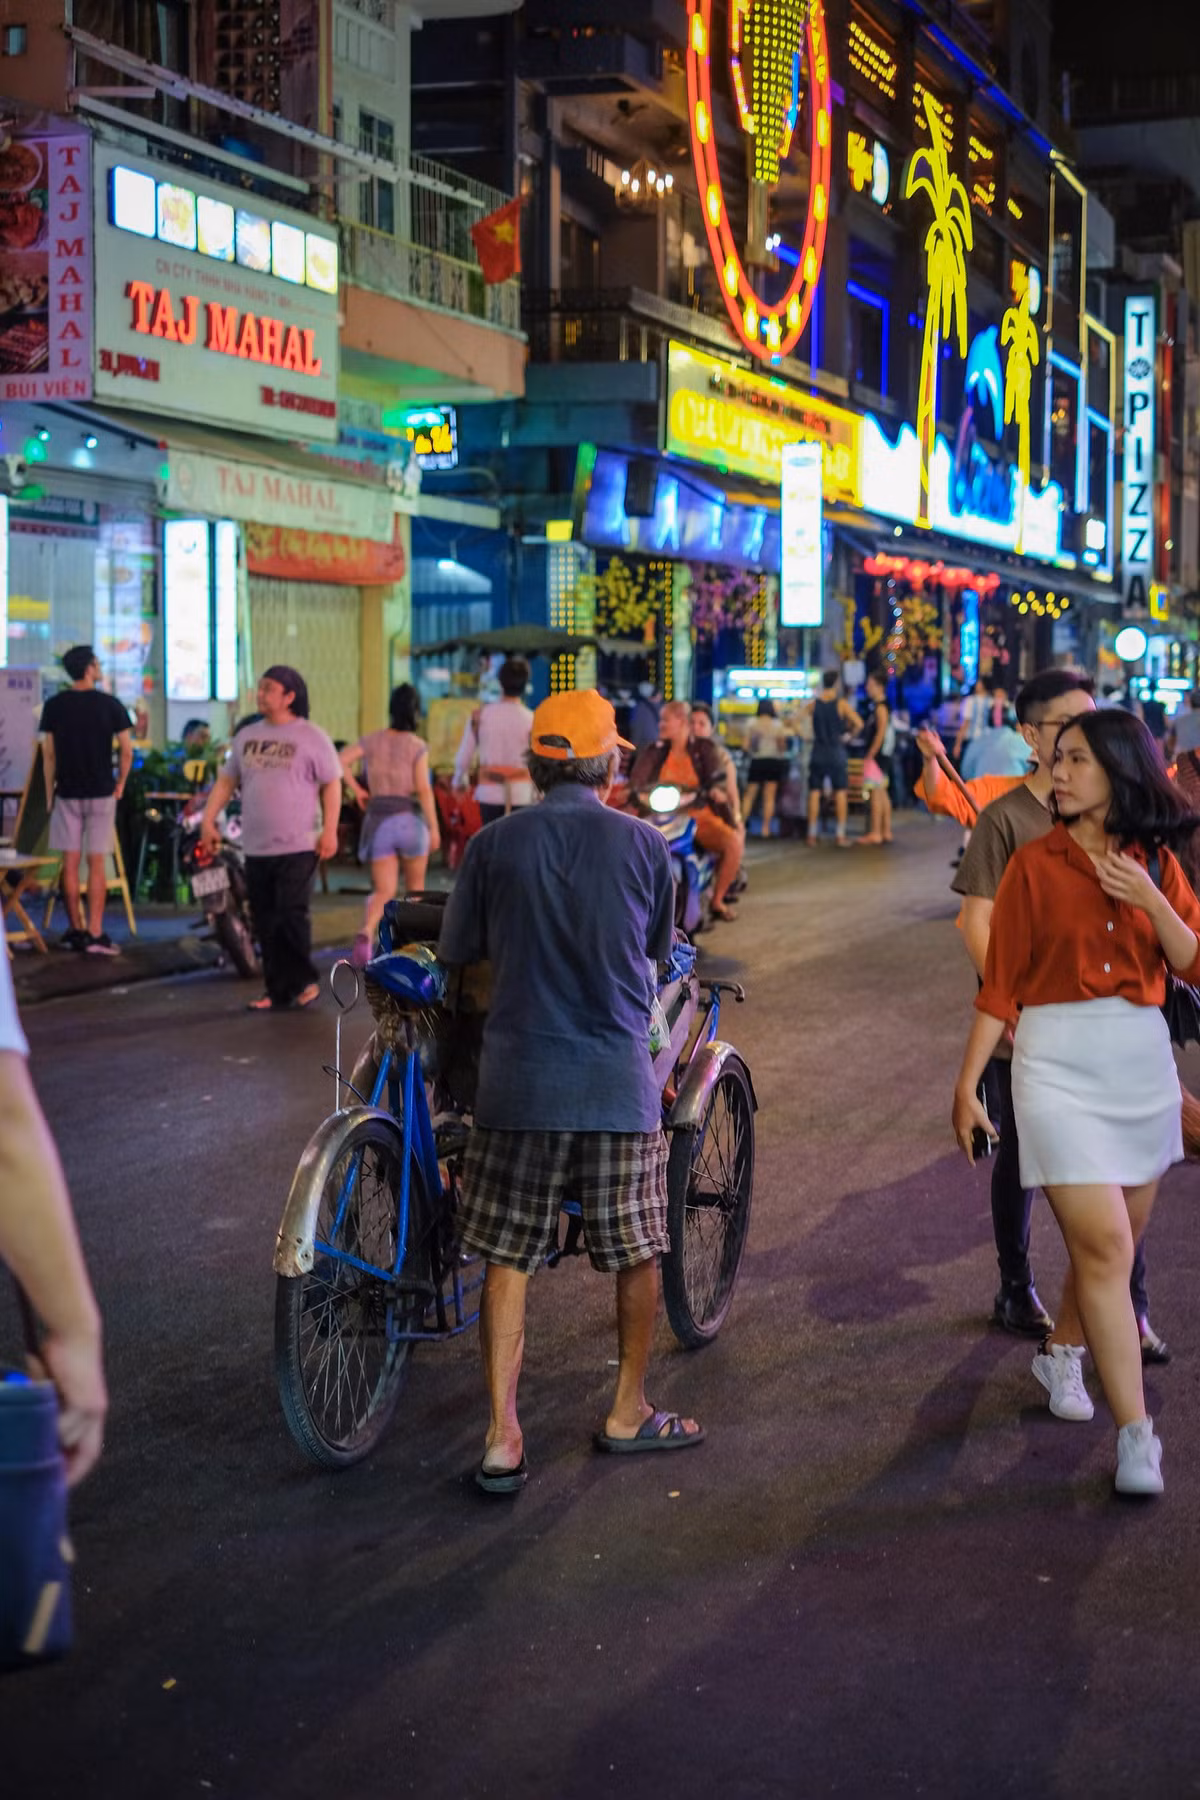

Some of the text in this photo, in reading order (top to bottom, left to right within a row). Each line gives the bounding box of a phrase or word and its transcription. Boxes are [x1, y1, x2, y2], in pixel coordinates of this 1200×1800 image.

[55, 147, 84, 368] TAJ MAHAL
[125, 280, 199, 345] TAJ
[205, 302, 322, 376] MAHAL
[217, 465, 341, 513] TAJ MAHAL
